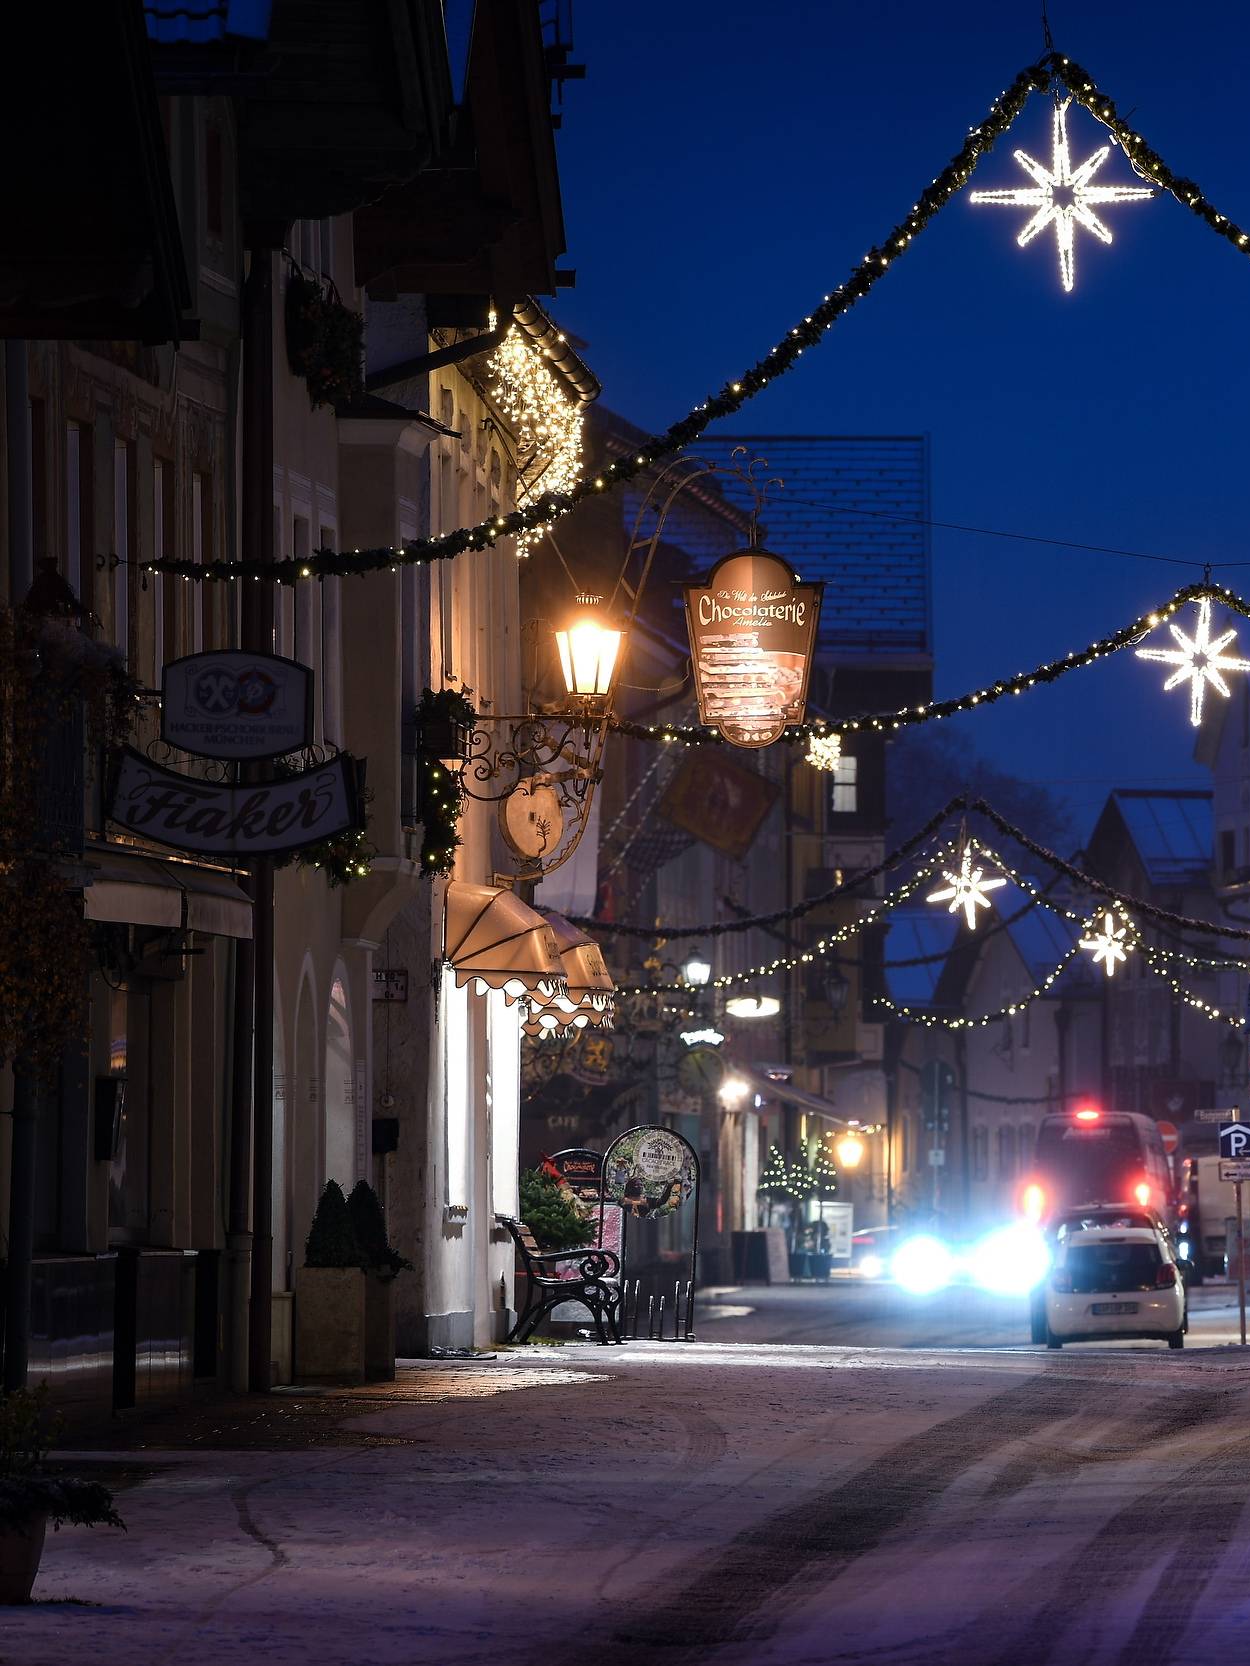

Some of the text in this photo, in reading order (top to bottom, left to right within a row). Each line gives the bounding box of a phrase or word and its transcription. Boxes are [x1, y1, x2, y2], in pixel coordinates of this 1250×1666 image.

[699, 595, 805, 626] Chocolaterie
[203, 734, 265, 745] MÜNCHEN
[125, 769, 336, 840] Fiaker
[1230, 1132, 1248, 1157] P
